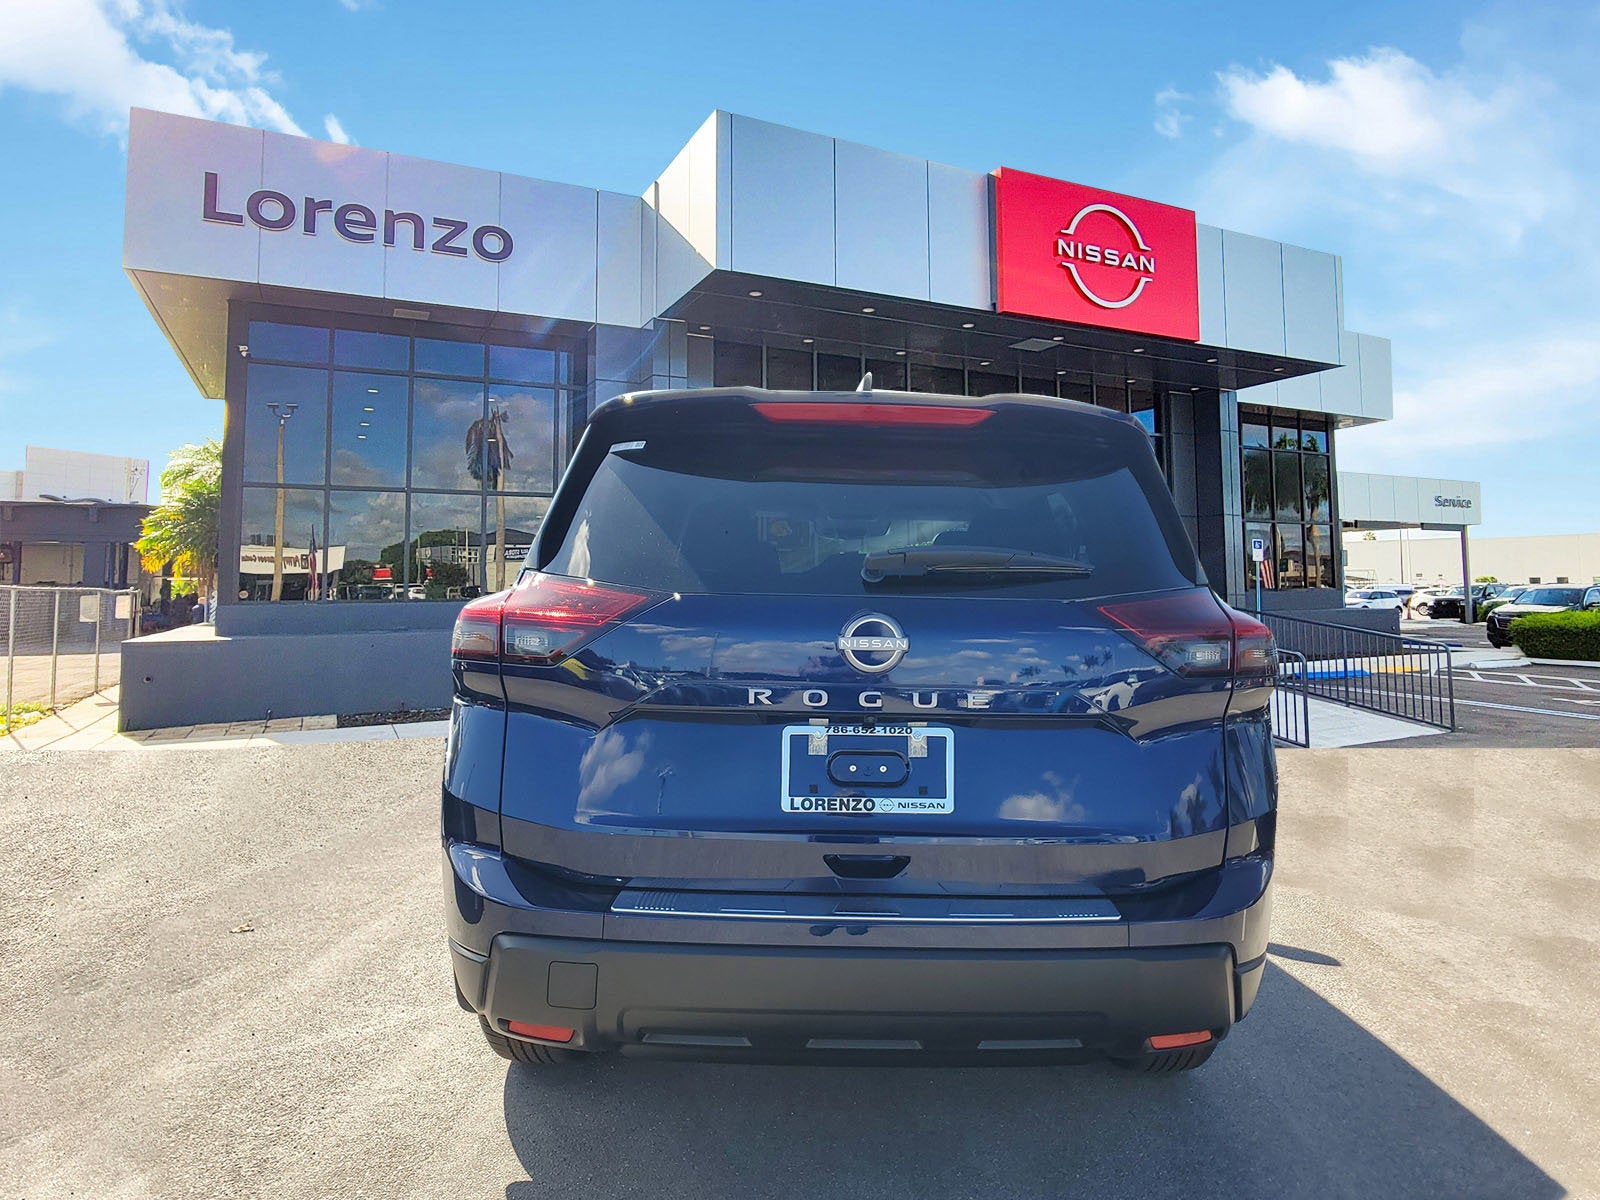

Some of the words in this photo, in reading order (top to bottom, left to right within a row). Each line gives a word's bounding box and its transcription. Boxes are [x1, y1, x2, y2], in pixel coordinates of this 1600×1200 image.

[202, 171, 514, 262] Lorenzo
[1057, 238, 1155, 273] NISSAN
[1434, 495, 1472, 508] Service
[840, 638, 908, 649] NISSAN
[748, 688, 991, 708] ROGUE
[825, 726, 913, 735] 786-652-1020
[790, 797, 876, 811] LORENZO
